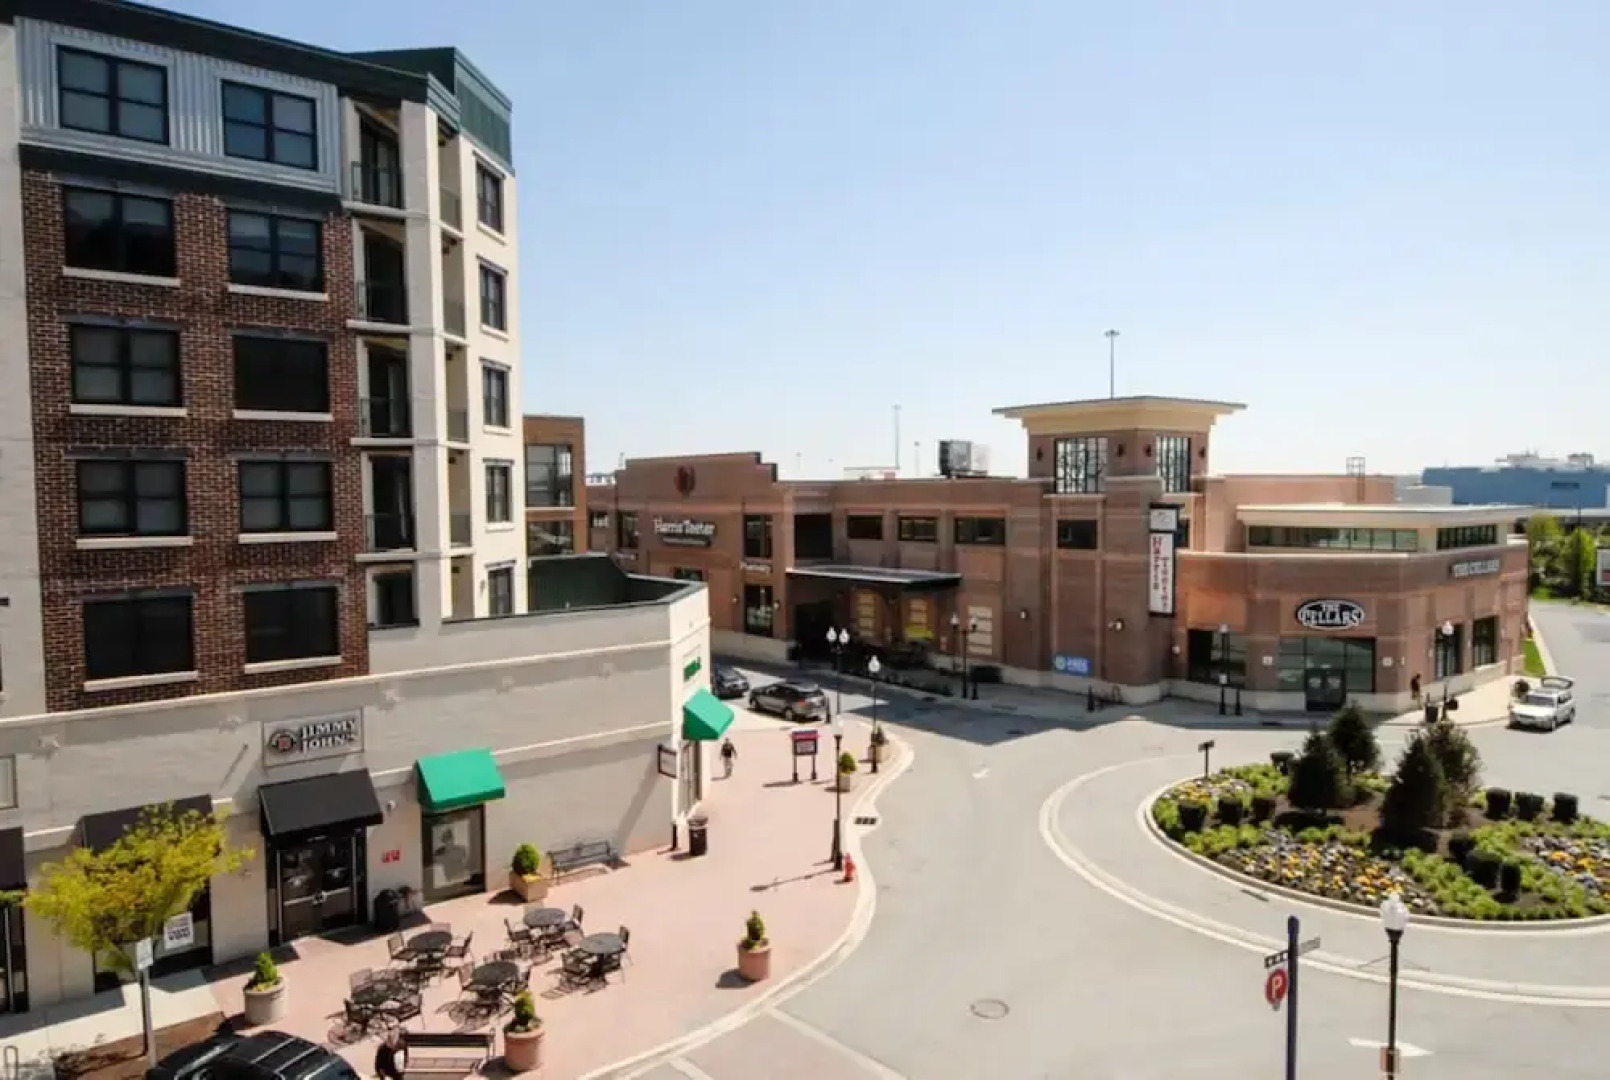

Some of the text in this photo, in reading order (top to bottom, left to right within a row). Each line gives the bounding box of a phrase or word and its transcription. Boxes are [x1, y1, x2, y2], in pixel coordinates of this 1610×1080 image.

[1302, 609, 1360, 627] CELLARS
[302, 719, 357, 738] JIMMY
[1271, 976, 1283, 999] P
